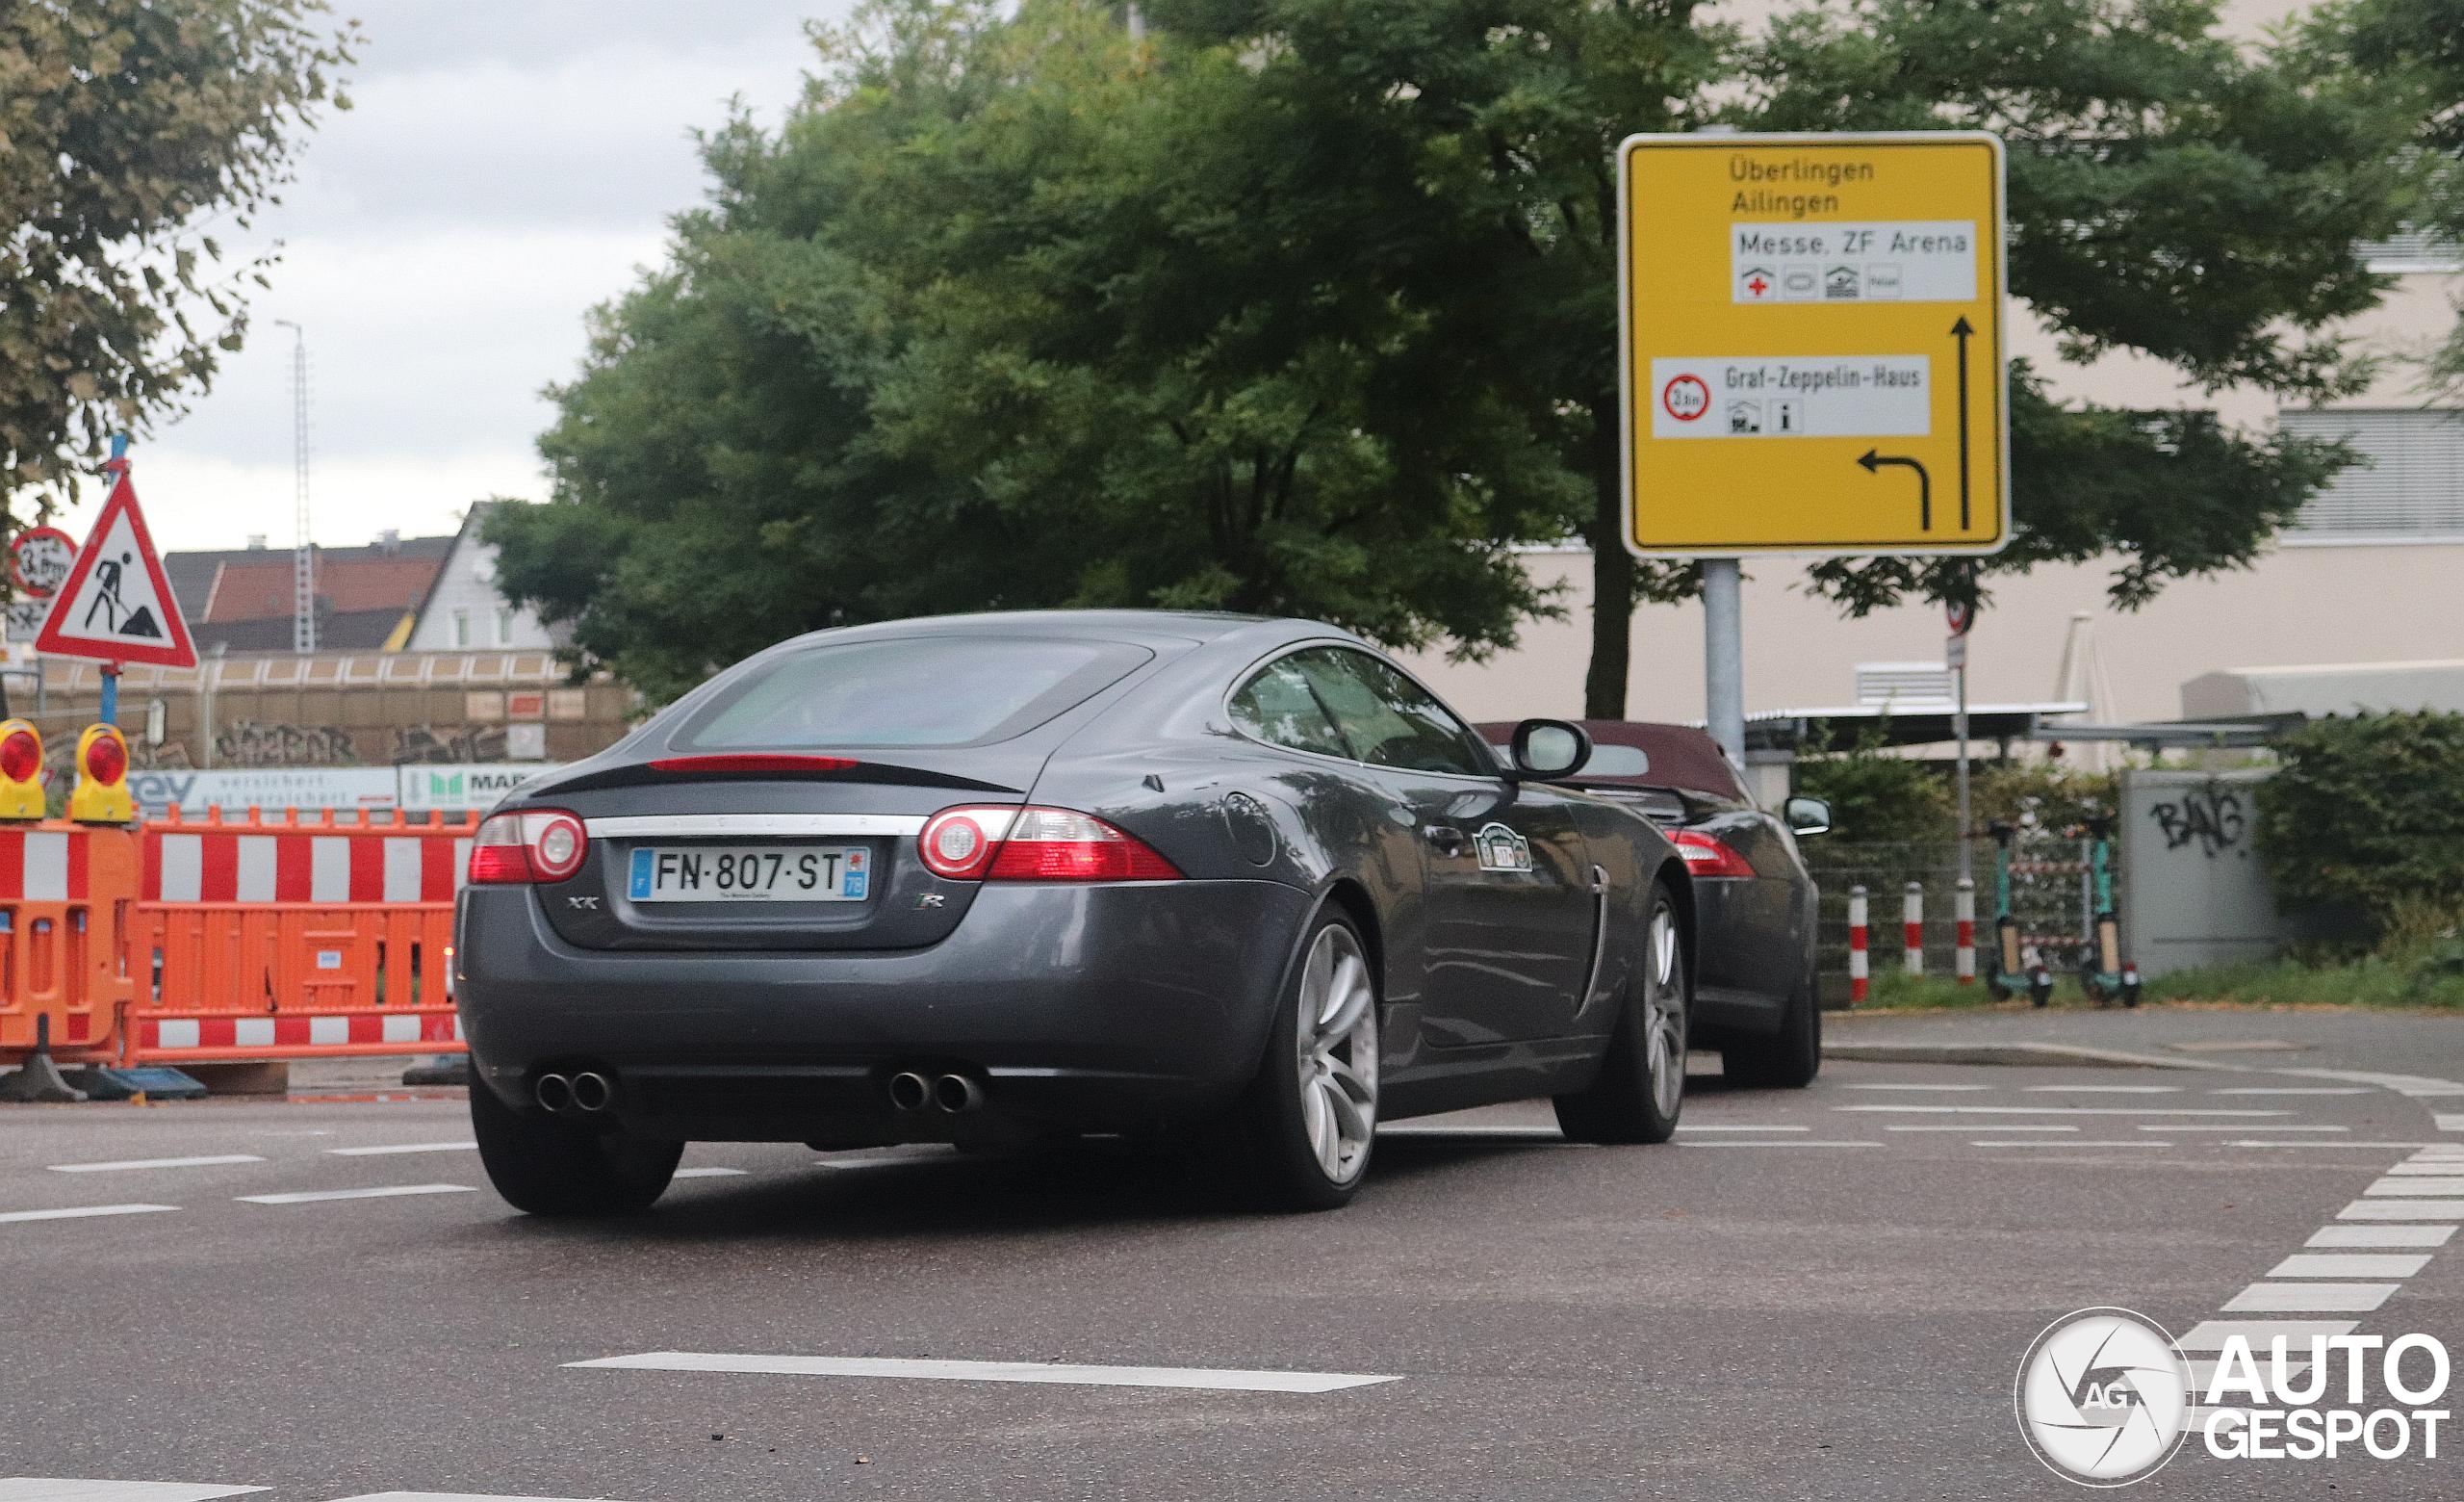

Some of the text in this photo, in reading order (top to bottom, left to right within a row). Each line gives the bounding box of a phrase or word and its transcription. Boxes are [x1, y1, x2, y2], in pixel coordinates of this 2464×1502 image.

[1731, 154, 1874, 188] Überlingen
[1732, 192, 1839, 219] Ailingen
[1842, 230, 1874, 254] ZF
[1889, 230, 1967, 253] Arena
[1726, 365, 1922, 393] Graf-Zeppelin-Haus
